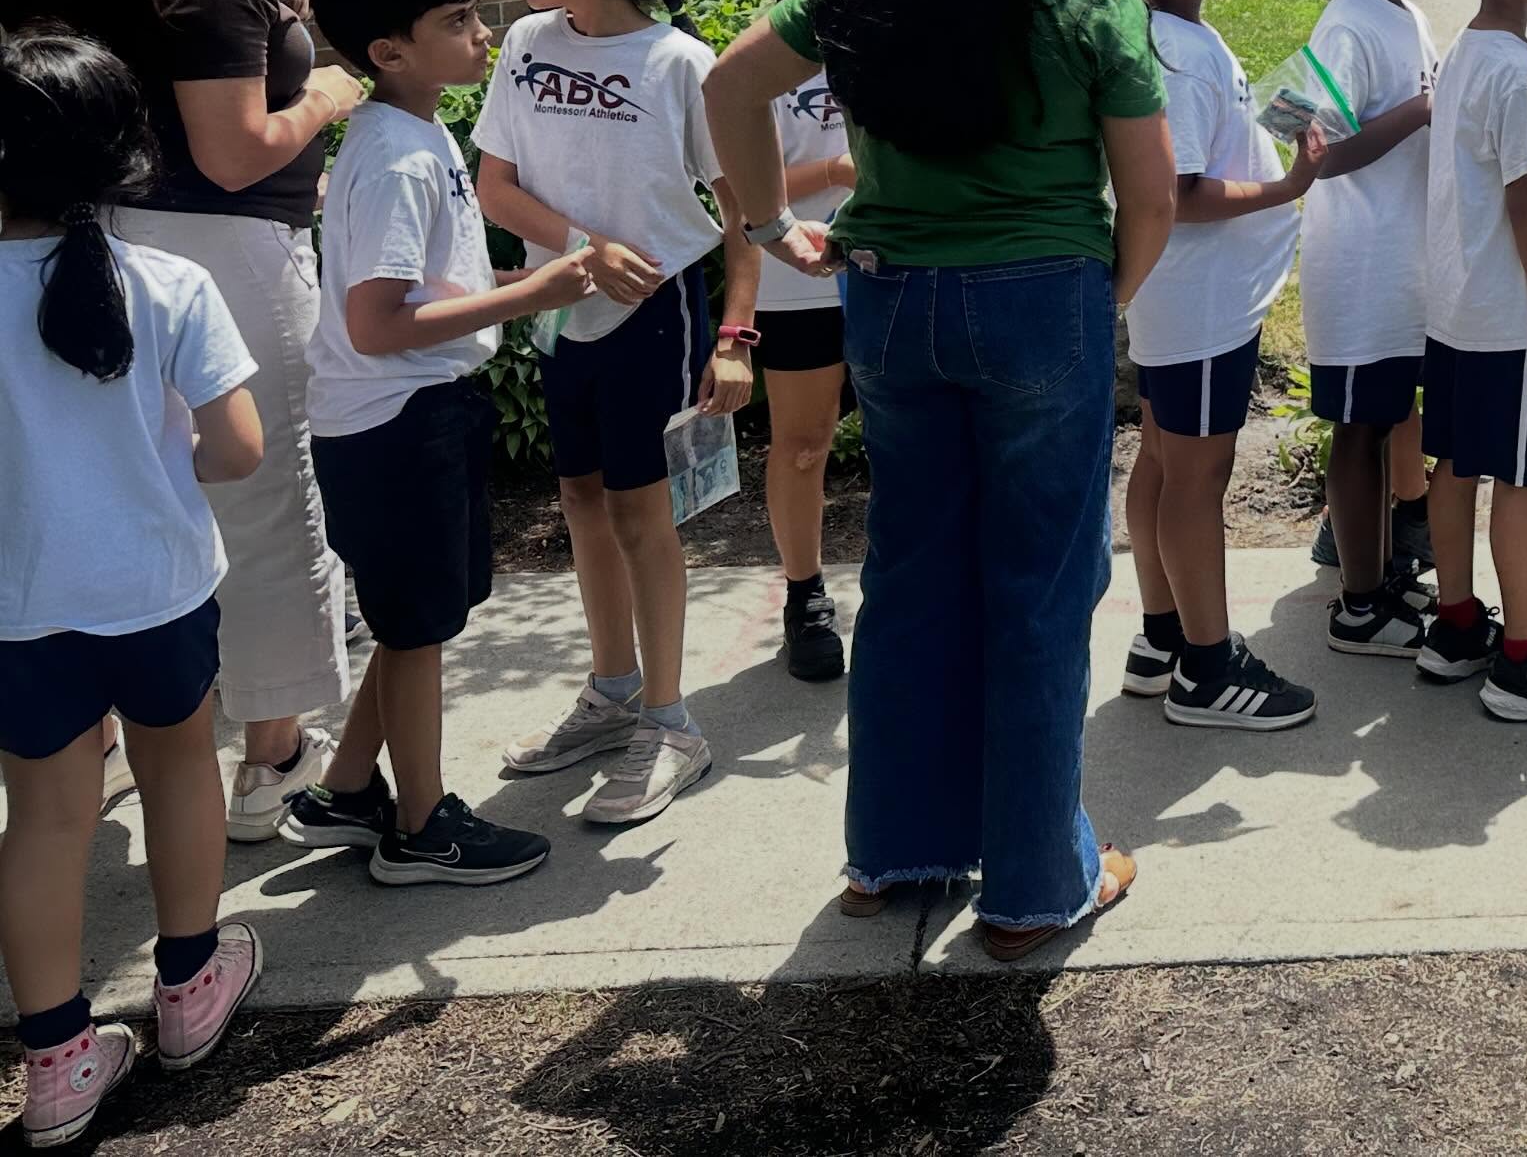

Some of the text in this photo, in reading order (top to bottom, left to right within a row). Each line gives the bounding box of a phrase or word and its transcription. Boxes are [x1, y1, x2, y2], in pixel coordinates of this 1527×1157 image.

[537, 71, 631, 109] ABC
[534, 102, 638, 123] Montessori Athletics
